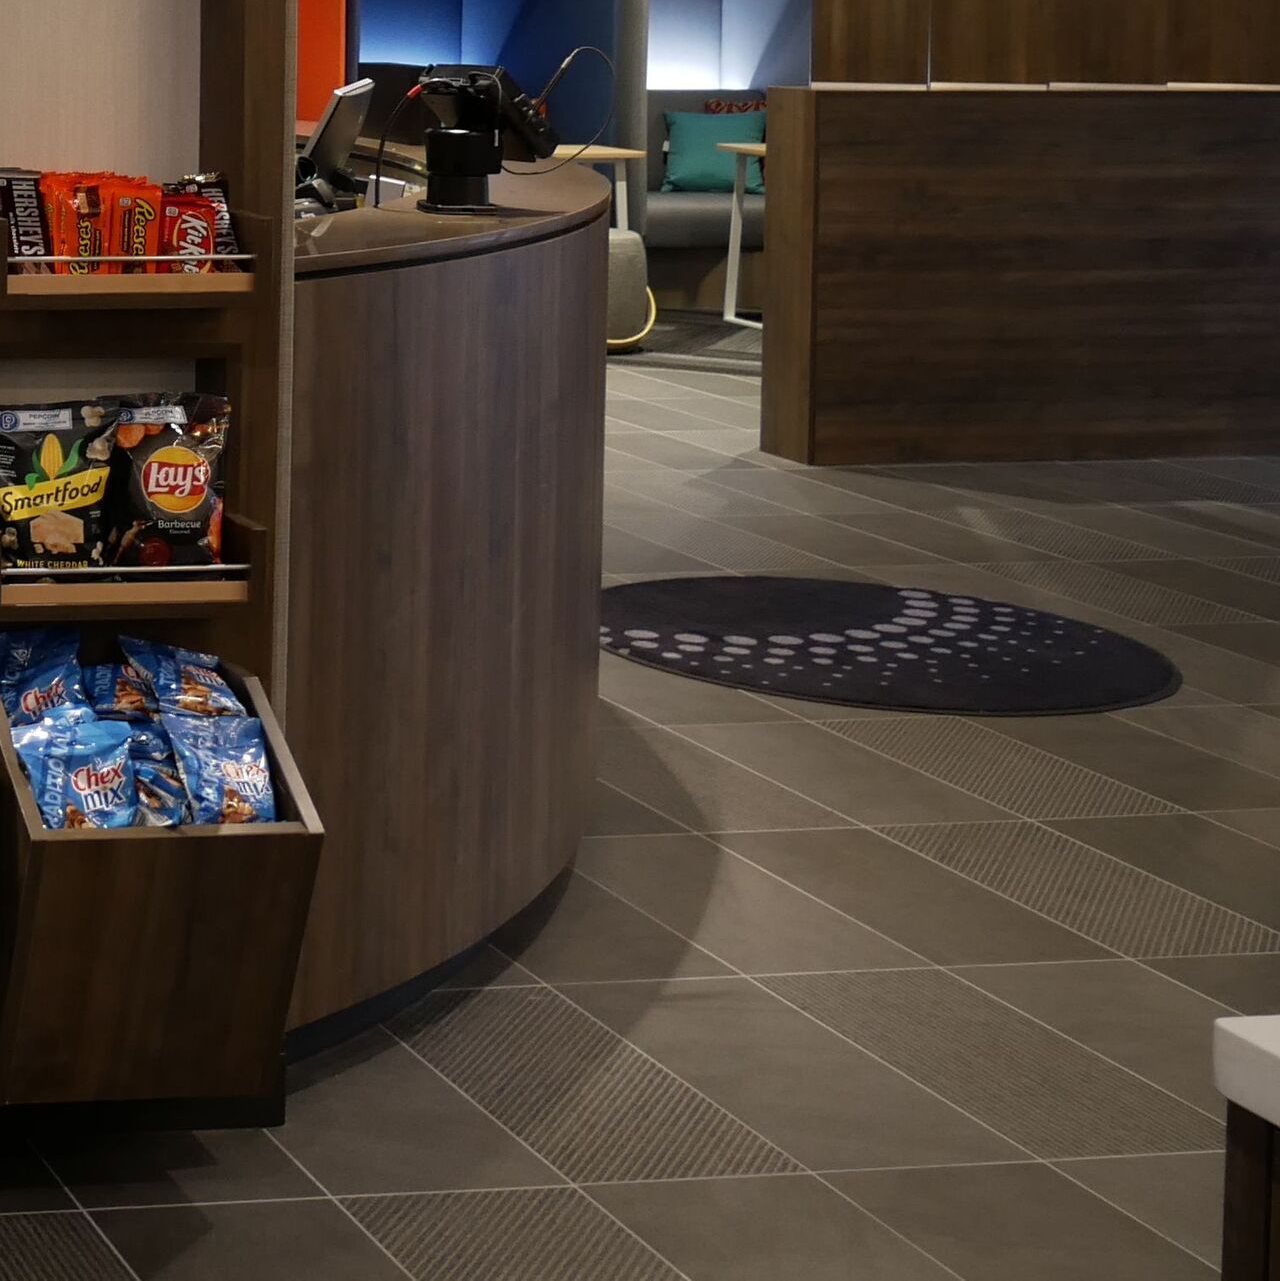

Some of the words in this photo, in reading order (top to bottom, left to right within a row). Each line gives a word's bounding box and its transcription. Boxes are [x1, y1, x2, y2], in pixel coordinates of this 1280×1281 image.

[11, 180, 45, 256] HERSHEY'S
[131, 197, 155, 255] Reese
[147, 460, 208, 498] Lay's
[1, 475, 103, 515] Smartfood
[157, 519, 202, 529] Barbecue
[16, 559, 45, 569] WHITE
[71, 762, 124, 791] Chex
[223, 762, 267, 781] Chex
[83, 781, 125, 812] mix
[232, 775, 272, 799] mix
